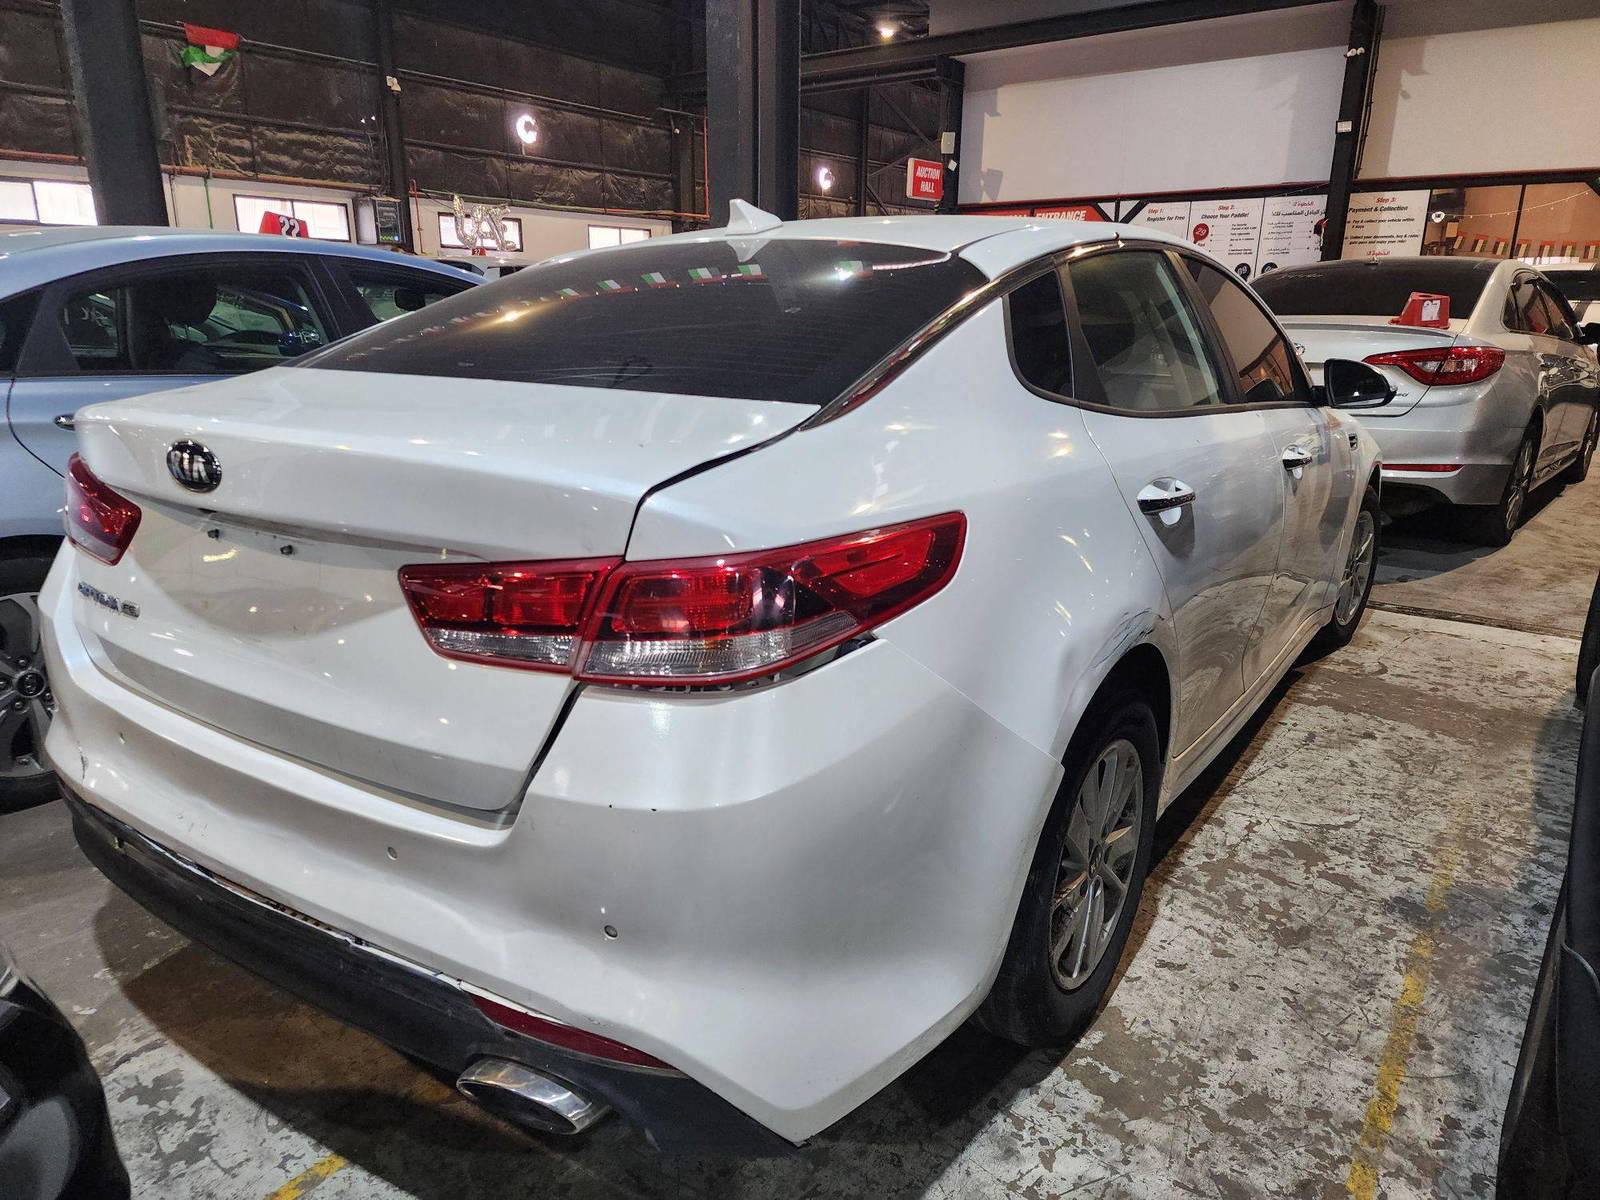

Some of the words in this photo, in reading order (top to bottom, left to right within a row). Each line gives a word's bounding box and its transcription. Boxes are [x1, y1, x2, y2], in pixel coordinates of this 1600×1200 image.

[916, 166, 941, 180] AUCTION
[920, 181, 935, 193] HALL
[1036, 210, 1087, 222] ENTRANCE
[279, 215, 300, 238] 22
